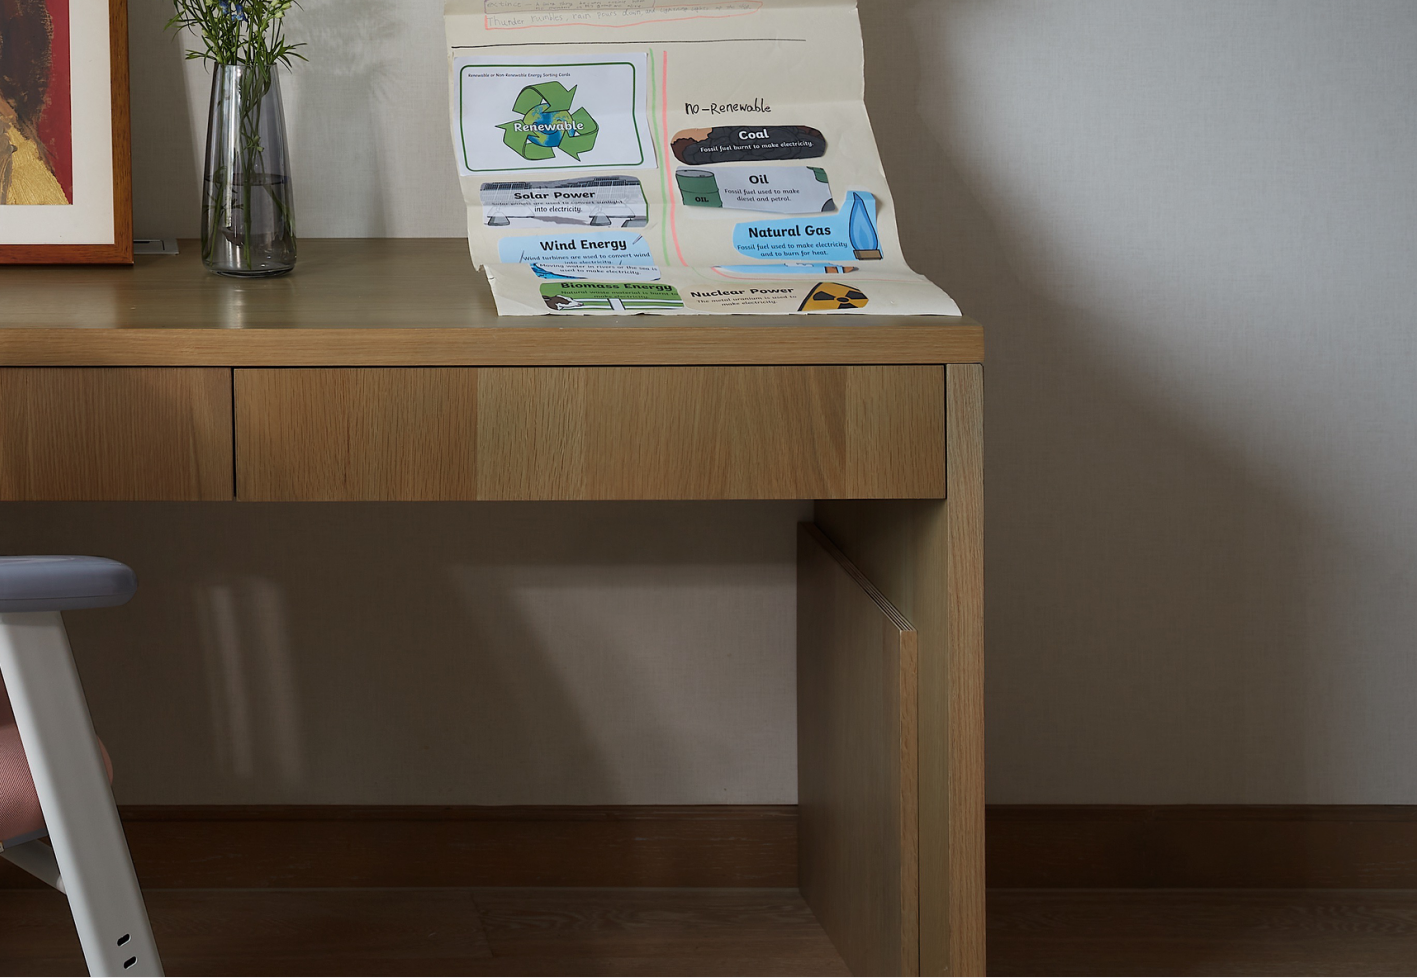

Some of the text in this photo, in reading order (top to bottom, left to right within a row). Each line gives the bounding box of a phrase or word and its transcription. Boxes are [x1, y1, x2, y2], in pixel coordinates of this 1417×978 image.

[487, 15, 525, 27] Thunder
[572, 12, 592, 20] rain
[513, 120, 584, 133] Renewable
[737, 129, 770, 140] Coal
[700, 145, 718, 153] Fossil
[719, 144, 732, 153] fuel
[780, 140, 813, 148] electricity.
[748, 174, 770, 185] Oil
[514, 191, 596, 201] Solar Power
[743, 188, 757, 196] fuel
[534, 205, 583, 214] into electricity.
[748, 224, 832, 239] Natural Gas
[539, 239, 627, 252] Wind Energy
[757, 243, 770, 252] fuel
[815, 241, 848, 249] electricity
[632, 251, 651, 259] wind
[690, 288, 746, 299] Nuclear
[750, 286, 794, 295] Power
